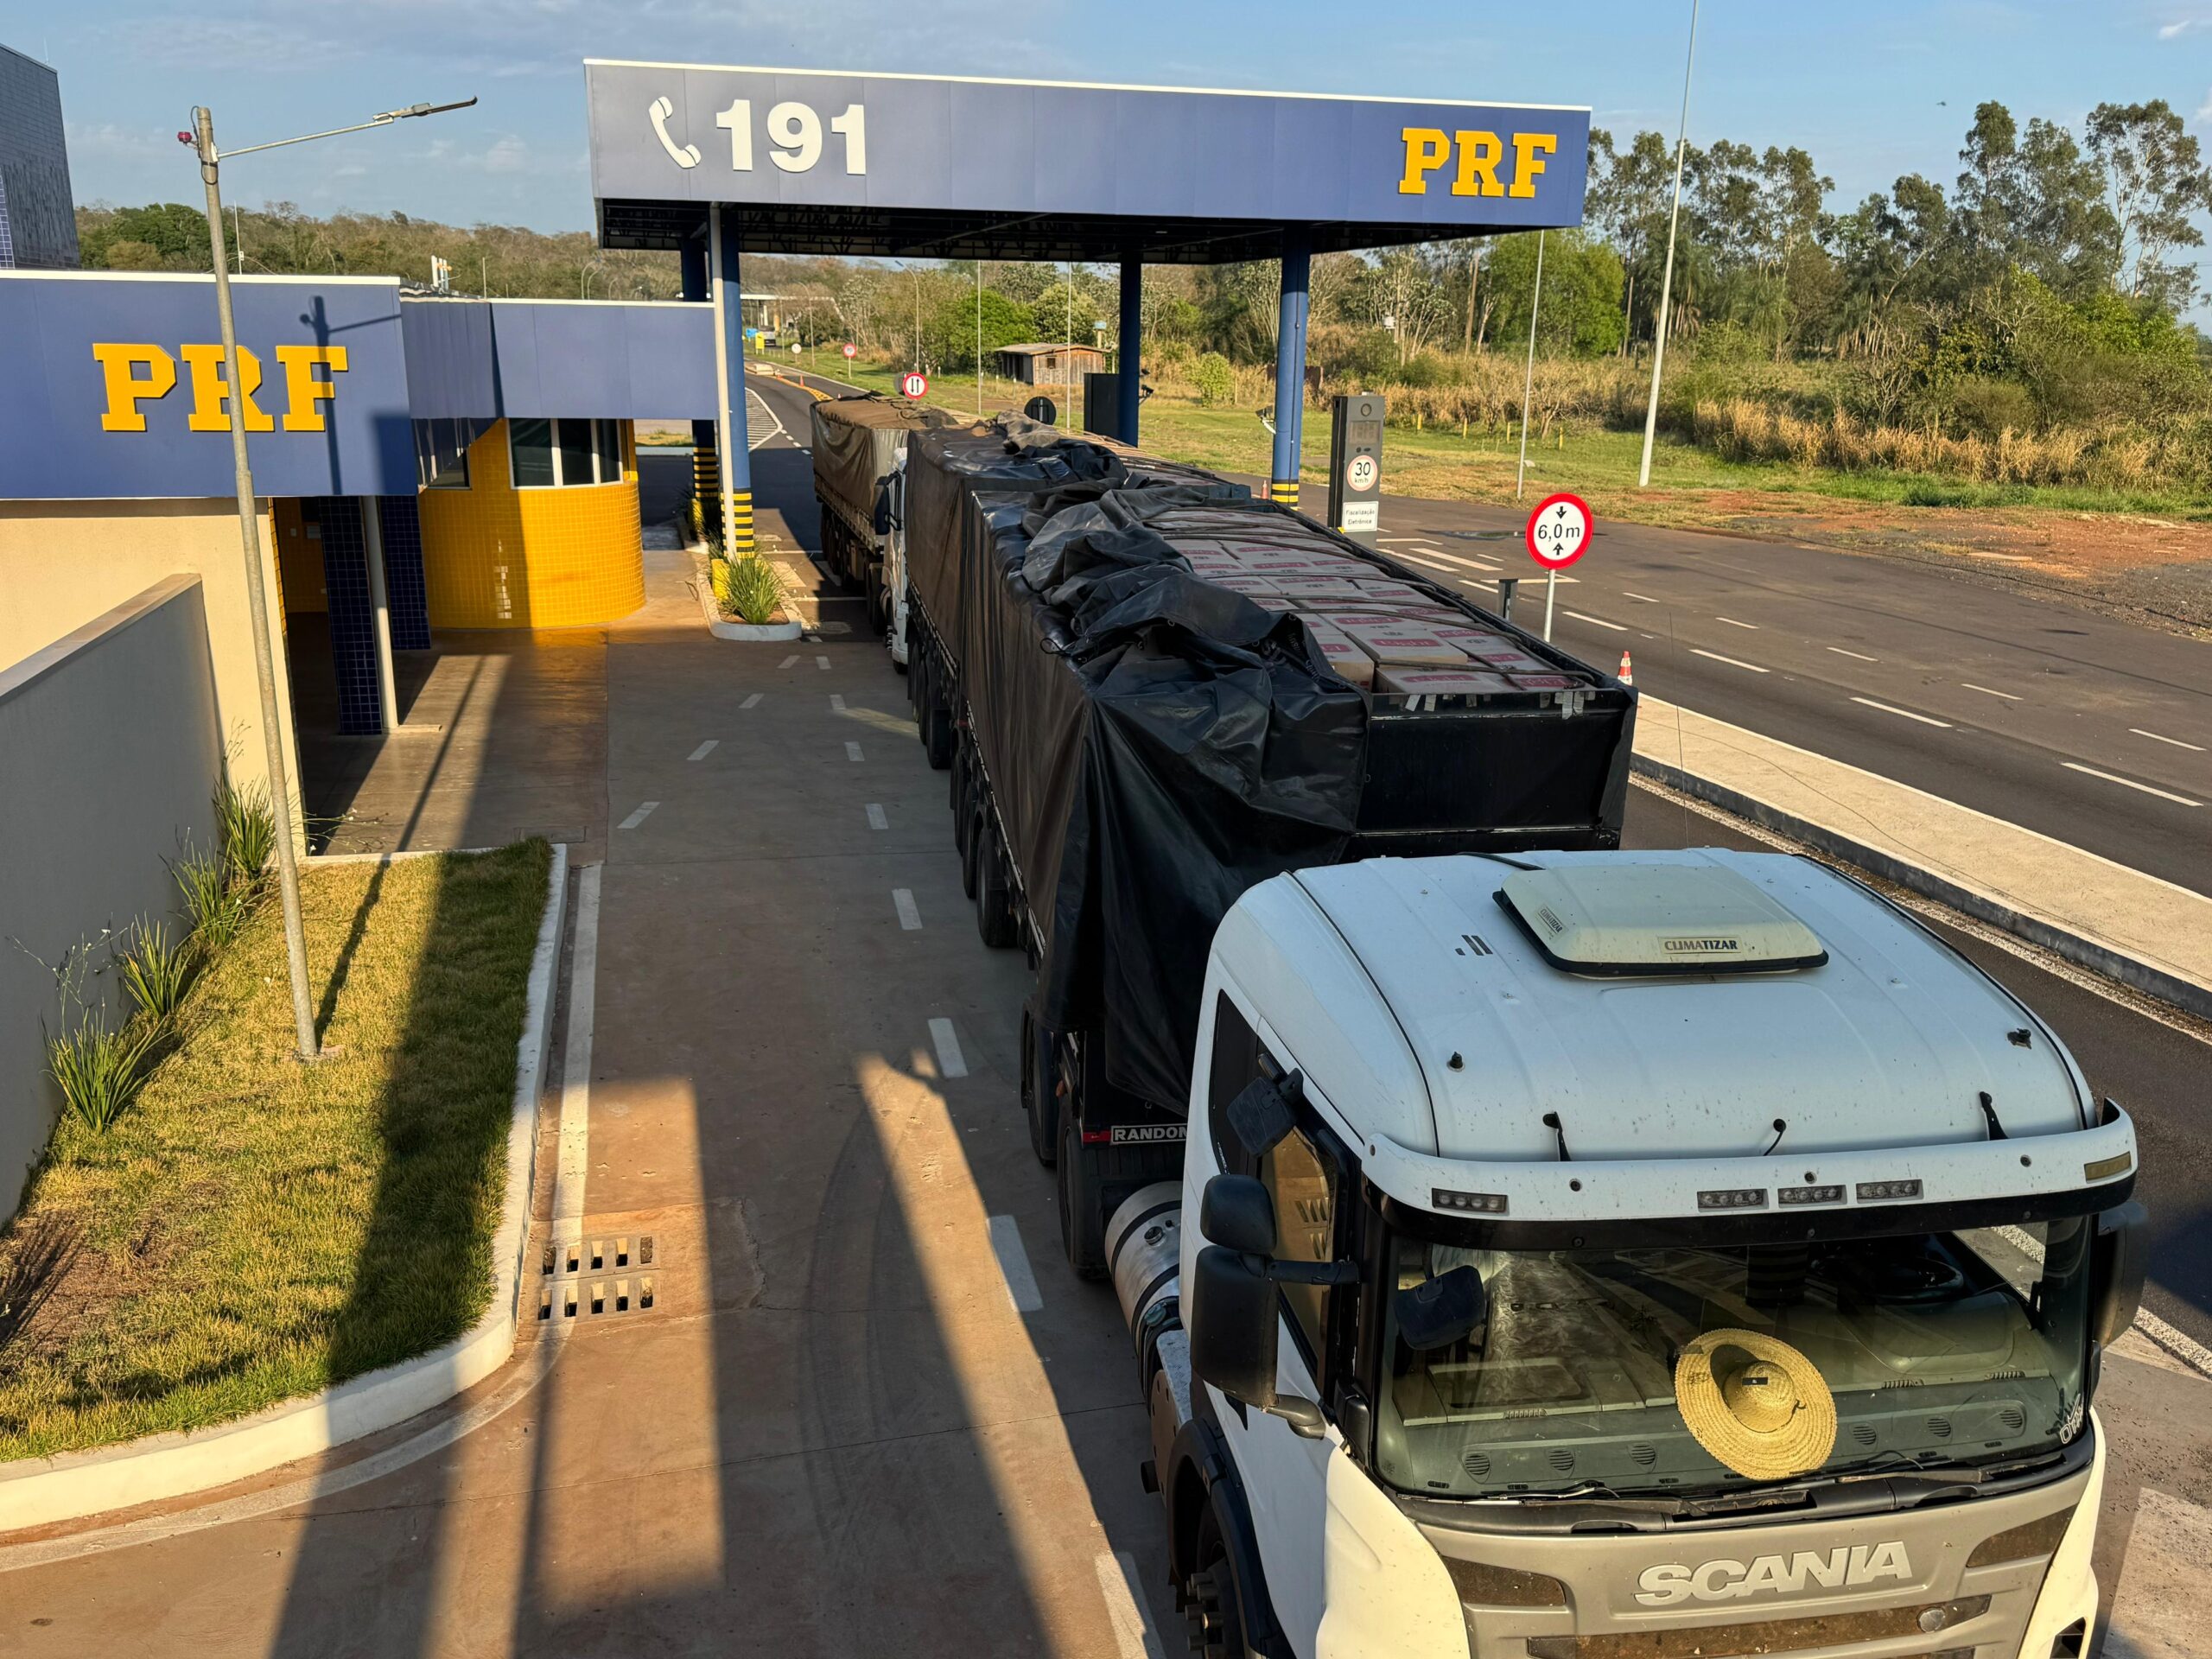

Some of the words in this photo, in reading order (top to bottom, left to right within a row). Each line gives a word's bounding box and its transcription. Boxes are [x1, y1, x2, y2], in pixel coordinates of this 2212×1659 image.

[716, 99, 867, 176] 191
[1398, 127, 1557, 200] PRF
[92, 342, 348, 432] PRF
[1355, 461, 1371, 476] 30
[1664, 938, 1738, 951] CLIMATIZAR
[1635, 1541, 1912, 1606] SCANIA
